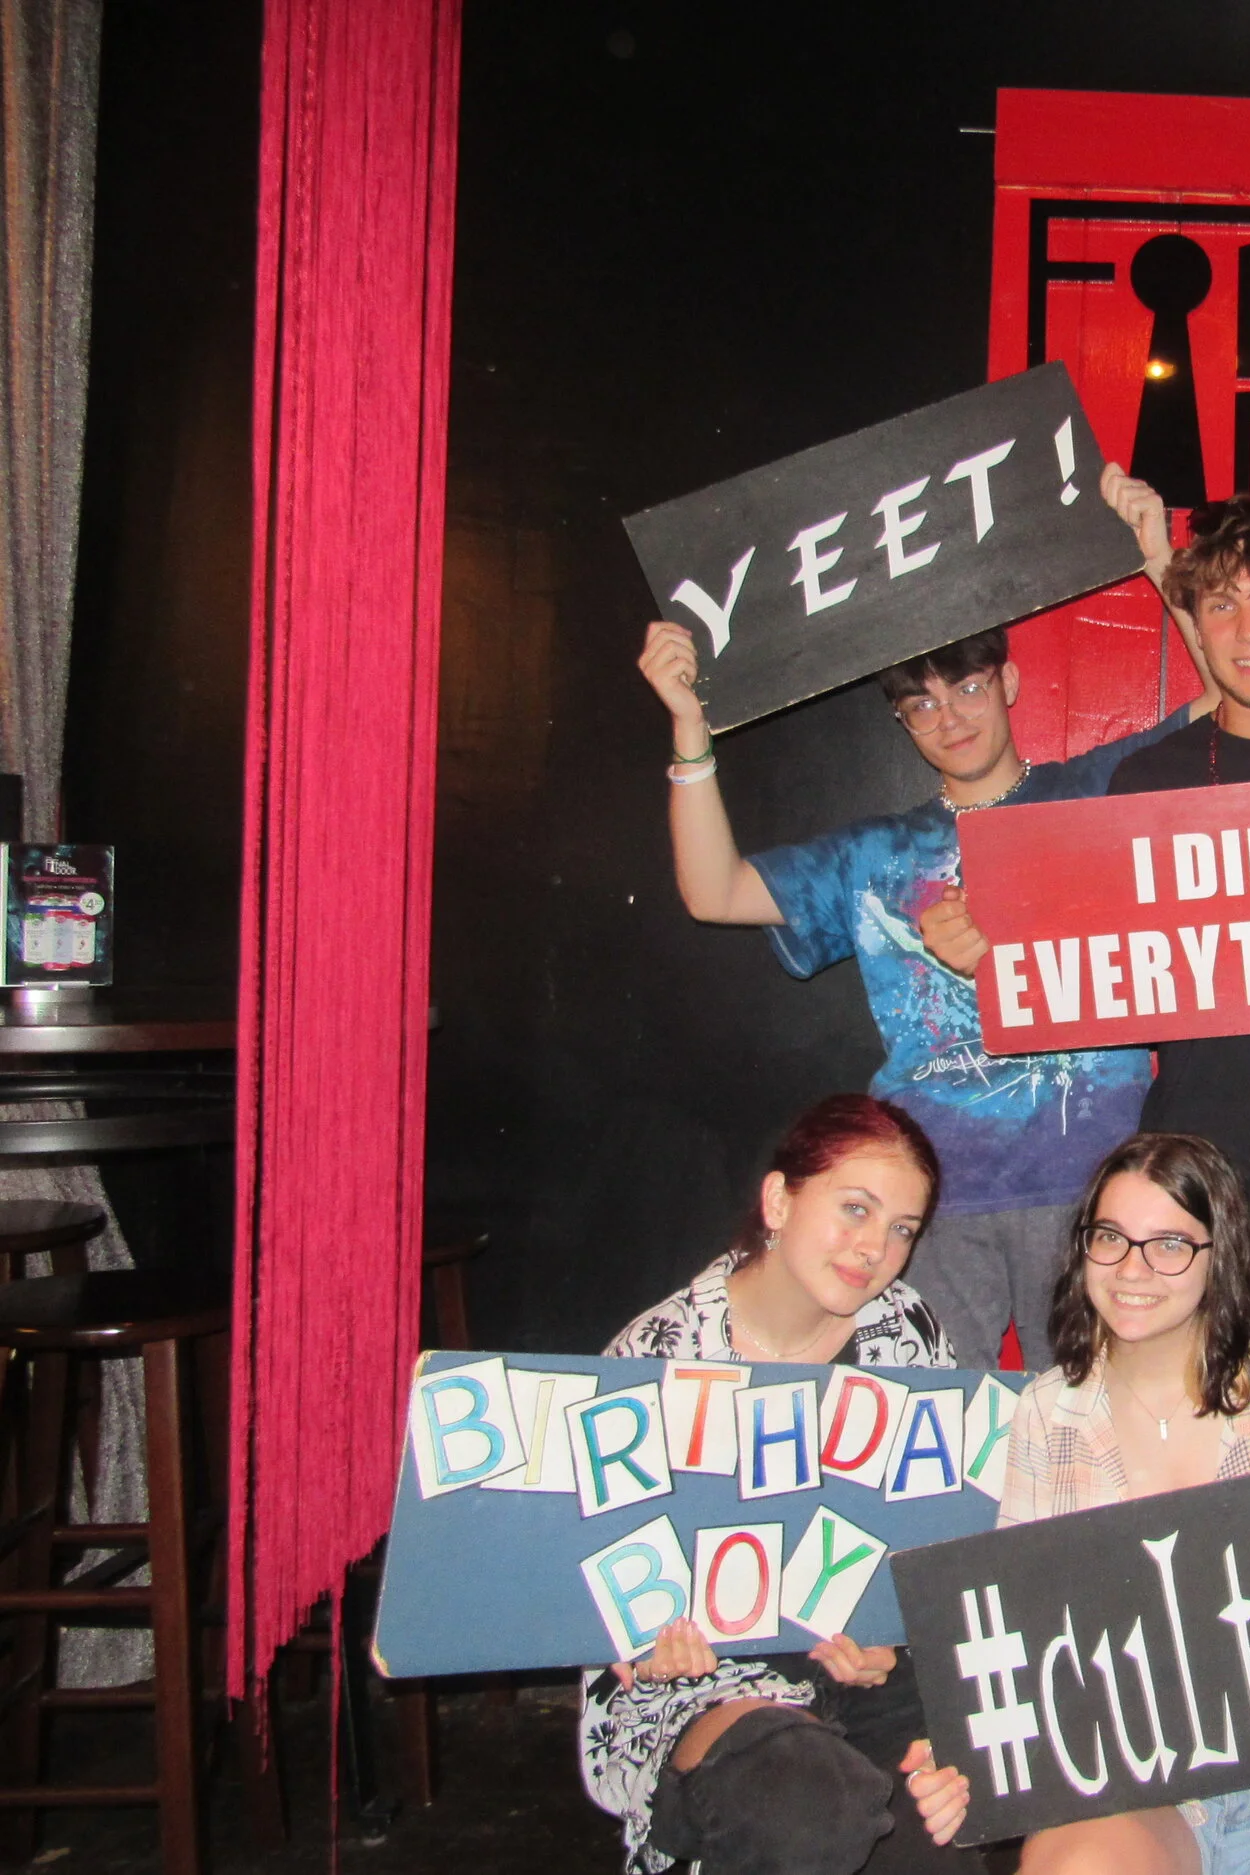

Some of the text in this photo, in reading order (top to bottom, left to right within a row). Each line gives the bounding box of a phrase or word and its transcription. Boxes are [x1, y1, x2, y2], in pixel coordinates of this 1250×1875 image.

[1132, 837, 1156, 904] I
[421, 1369, 1010, 1506] BIRTHDAY
[600, 1517, 873, 1647] BOY
